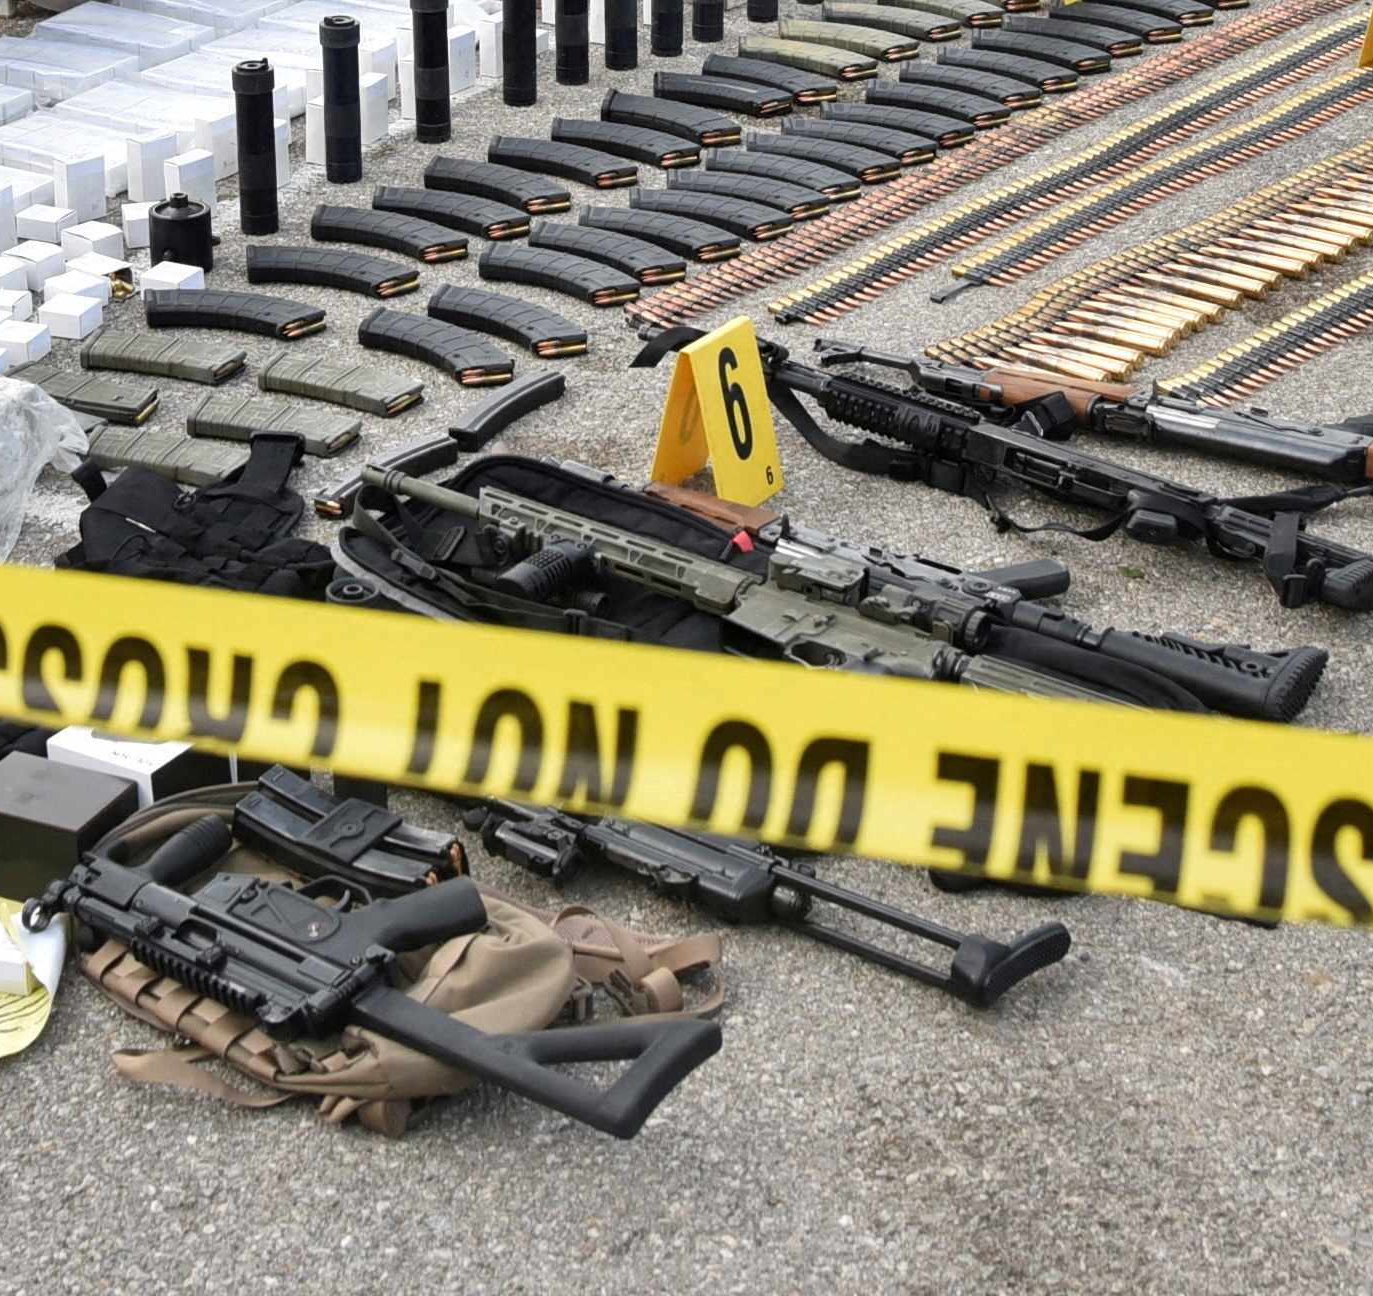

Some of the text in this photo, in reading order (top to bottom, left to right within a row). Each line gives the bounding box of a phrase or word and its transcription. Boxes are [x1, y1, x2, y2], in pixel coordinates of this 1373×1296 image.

[718, 346, 753, 461] 6
[765, 465, 774, 486] 6
[689, 719, 871, 850] DO
